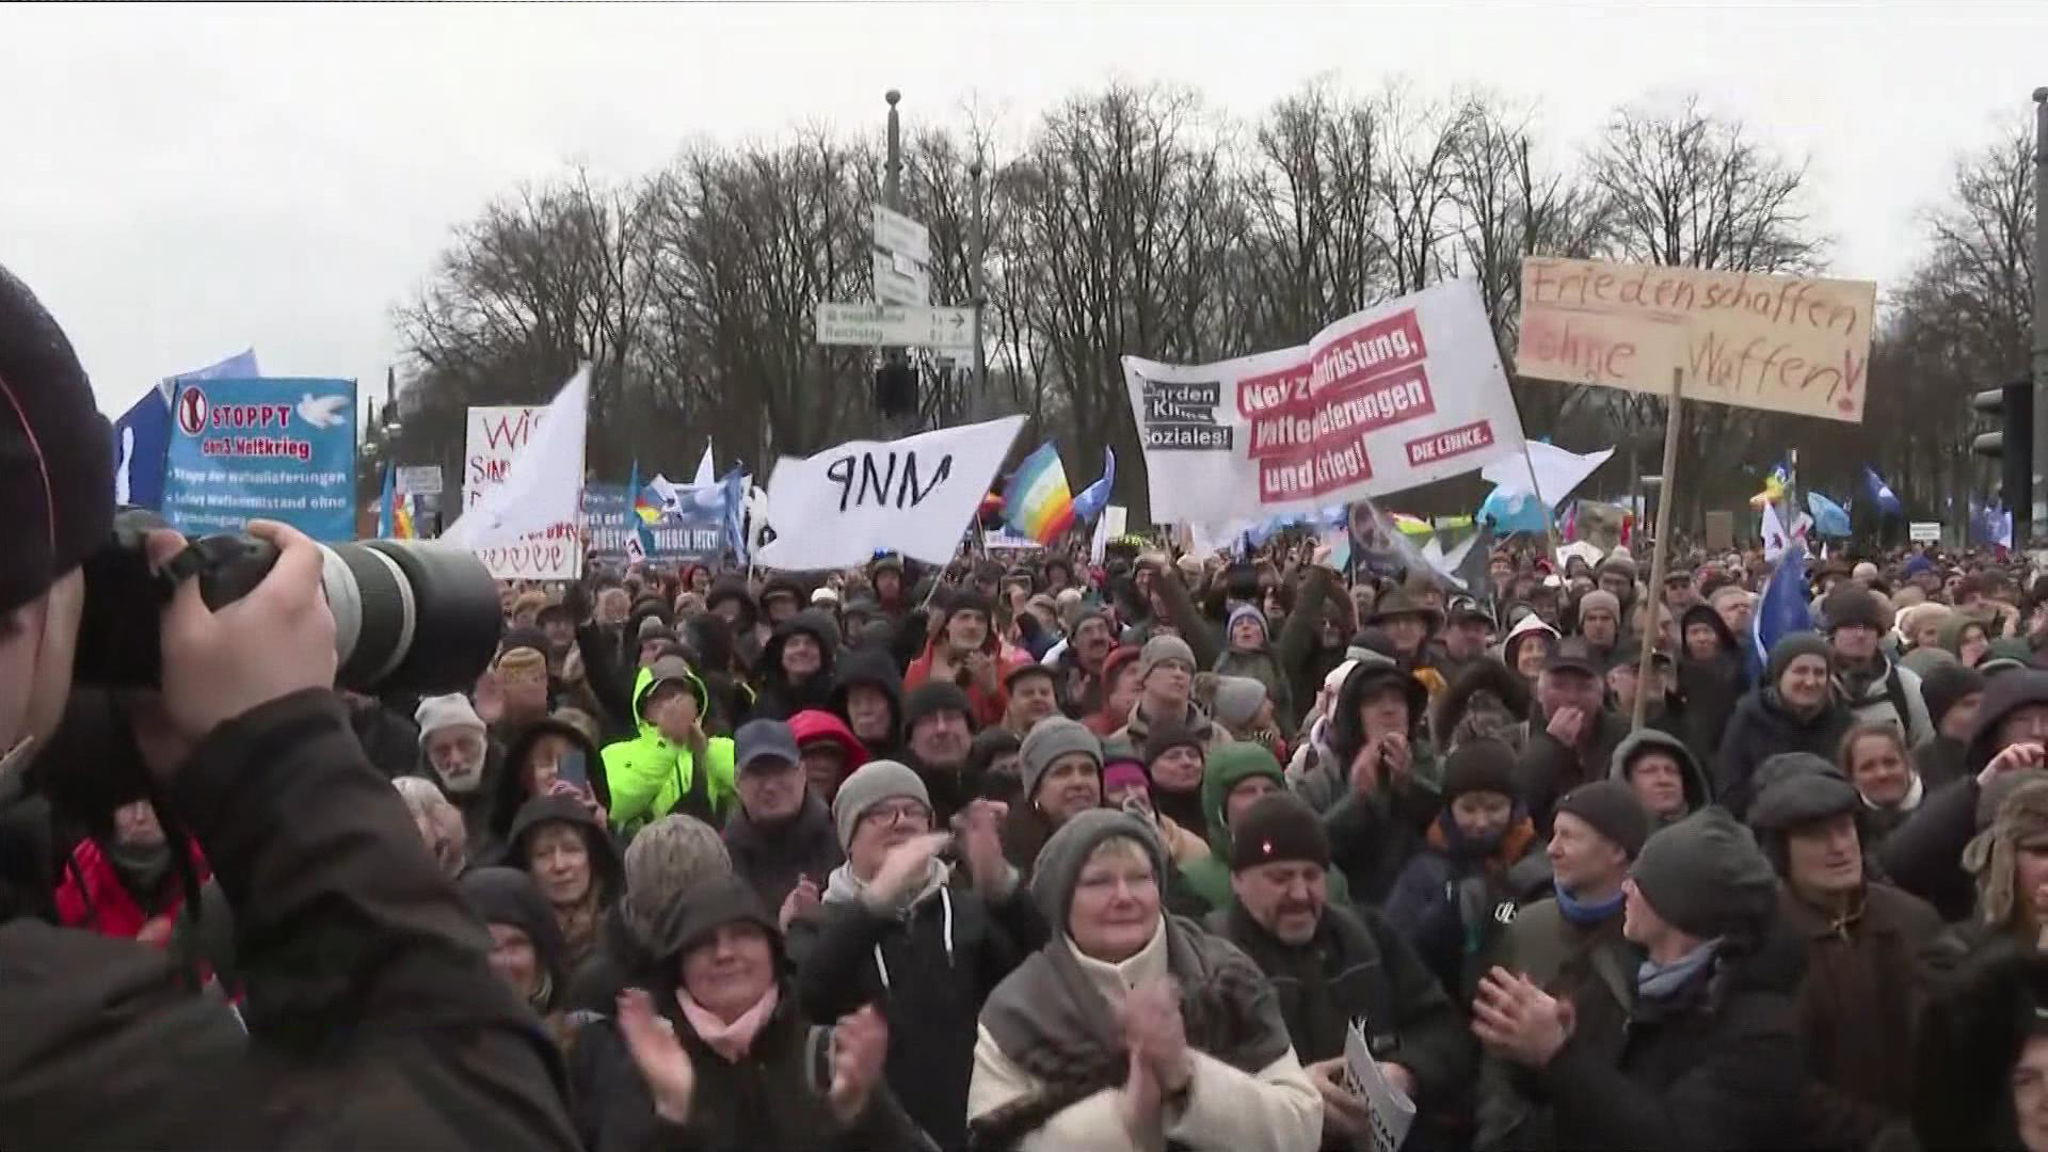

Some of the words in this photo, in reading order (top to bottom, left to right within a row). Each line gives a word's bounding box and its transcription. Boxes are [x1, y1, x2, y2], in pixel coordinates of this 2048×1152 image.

[1538, 319, 1637, 380] ohne
[1687, 330, 1867, 415] Waffen!
[212, 406, 291, 427] STOPPT
[1144, 426, 1229, 445] Soziales!
[1411, 443, 1435, 463] DIE
[1436, 426, 1489, 456] LINKE.
[236, 437, 309, 461] Weltkrieg
[1265, 457, 1314, 493] und
[310, 497, 346, 510] ohne
